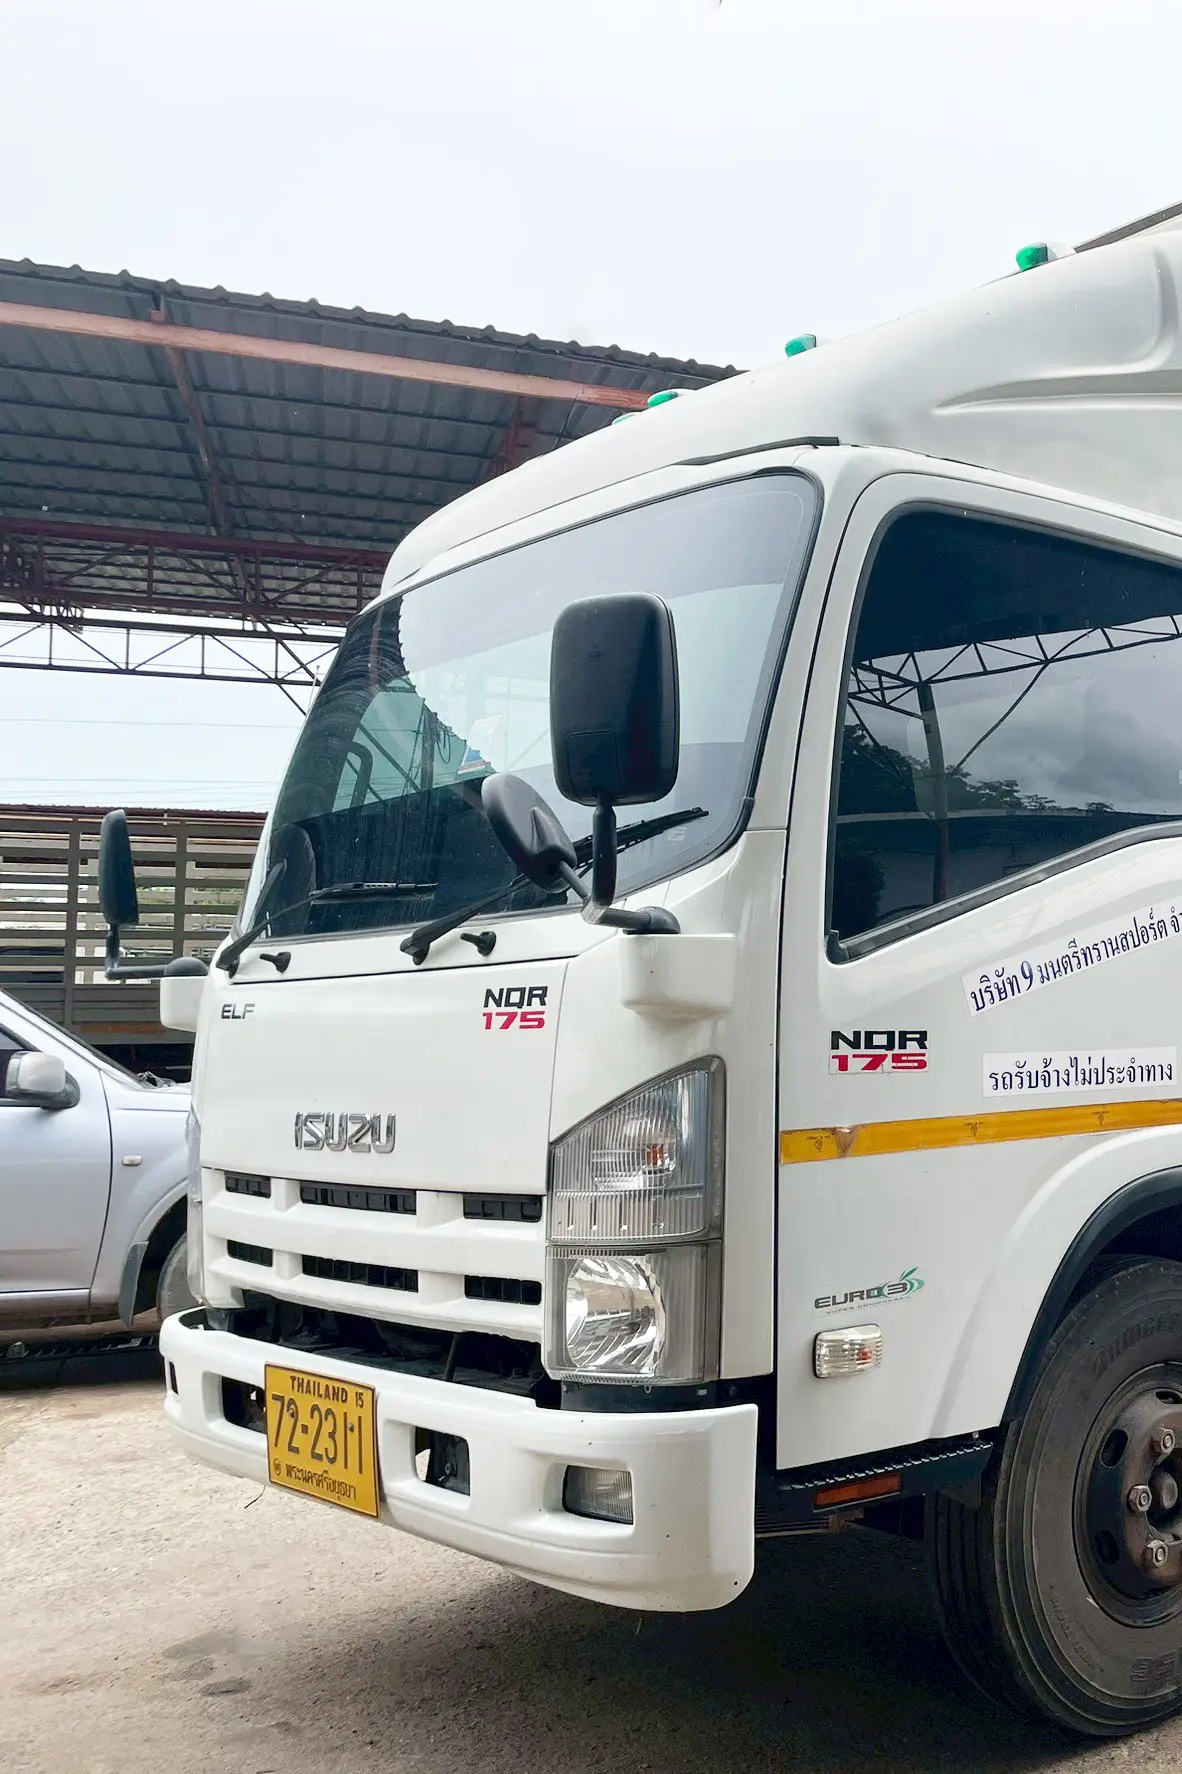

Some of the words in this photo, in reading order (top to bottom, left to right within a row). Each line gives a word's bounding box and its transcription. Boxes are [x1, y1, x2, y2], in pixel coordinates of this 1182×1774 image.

[483, 985, 549, 1009] NQR
[221, 1003, 256, 1020] ELF
[482, 1010, 546, 1030] 175
[830, 1030, 928, 1051] NQR
[831, 1052, 928, 1072] 175
[988, 1056, 1174, 1091] รถรับจ้างไม่ประจำทาง
[294, 1111, 397, 1154] ISUZU
[289, 1375, 348, 1403] THAILAND
[355, 1391, 364, 1409] 15
[271, 1393, 364, 1475] 72-2311
